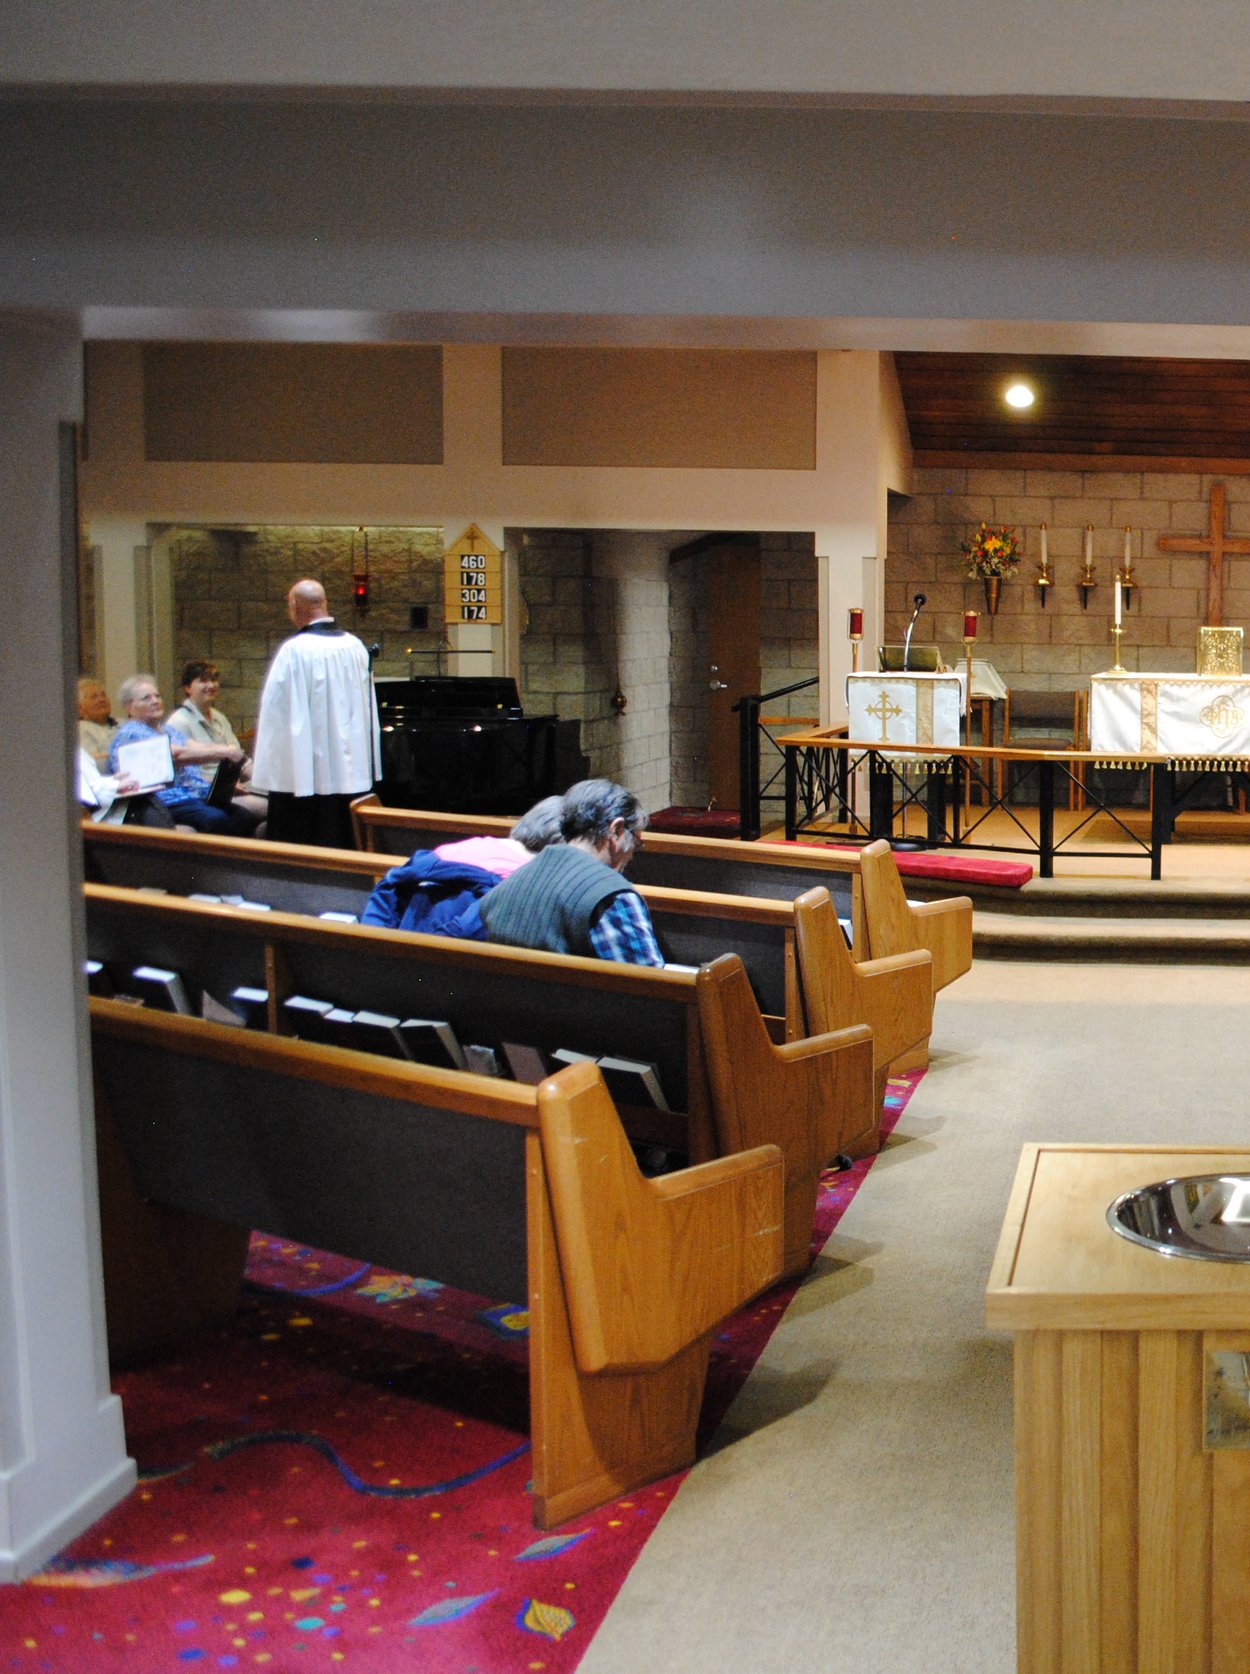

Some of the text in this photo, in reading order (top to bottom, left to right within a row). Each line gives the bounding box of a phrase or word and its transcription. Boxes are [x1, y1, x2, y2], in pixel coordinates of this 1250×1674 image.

[461, 555, 486, 569] 460
[463, 572, 486, 586] 178
[462, 589, 486, 602] 304
[464, 606, 486, 619] 174
